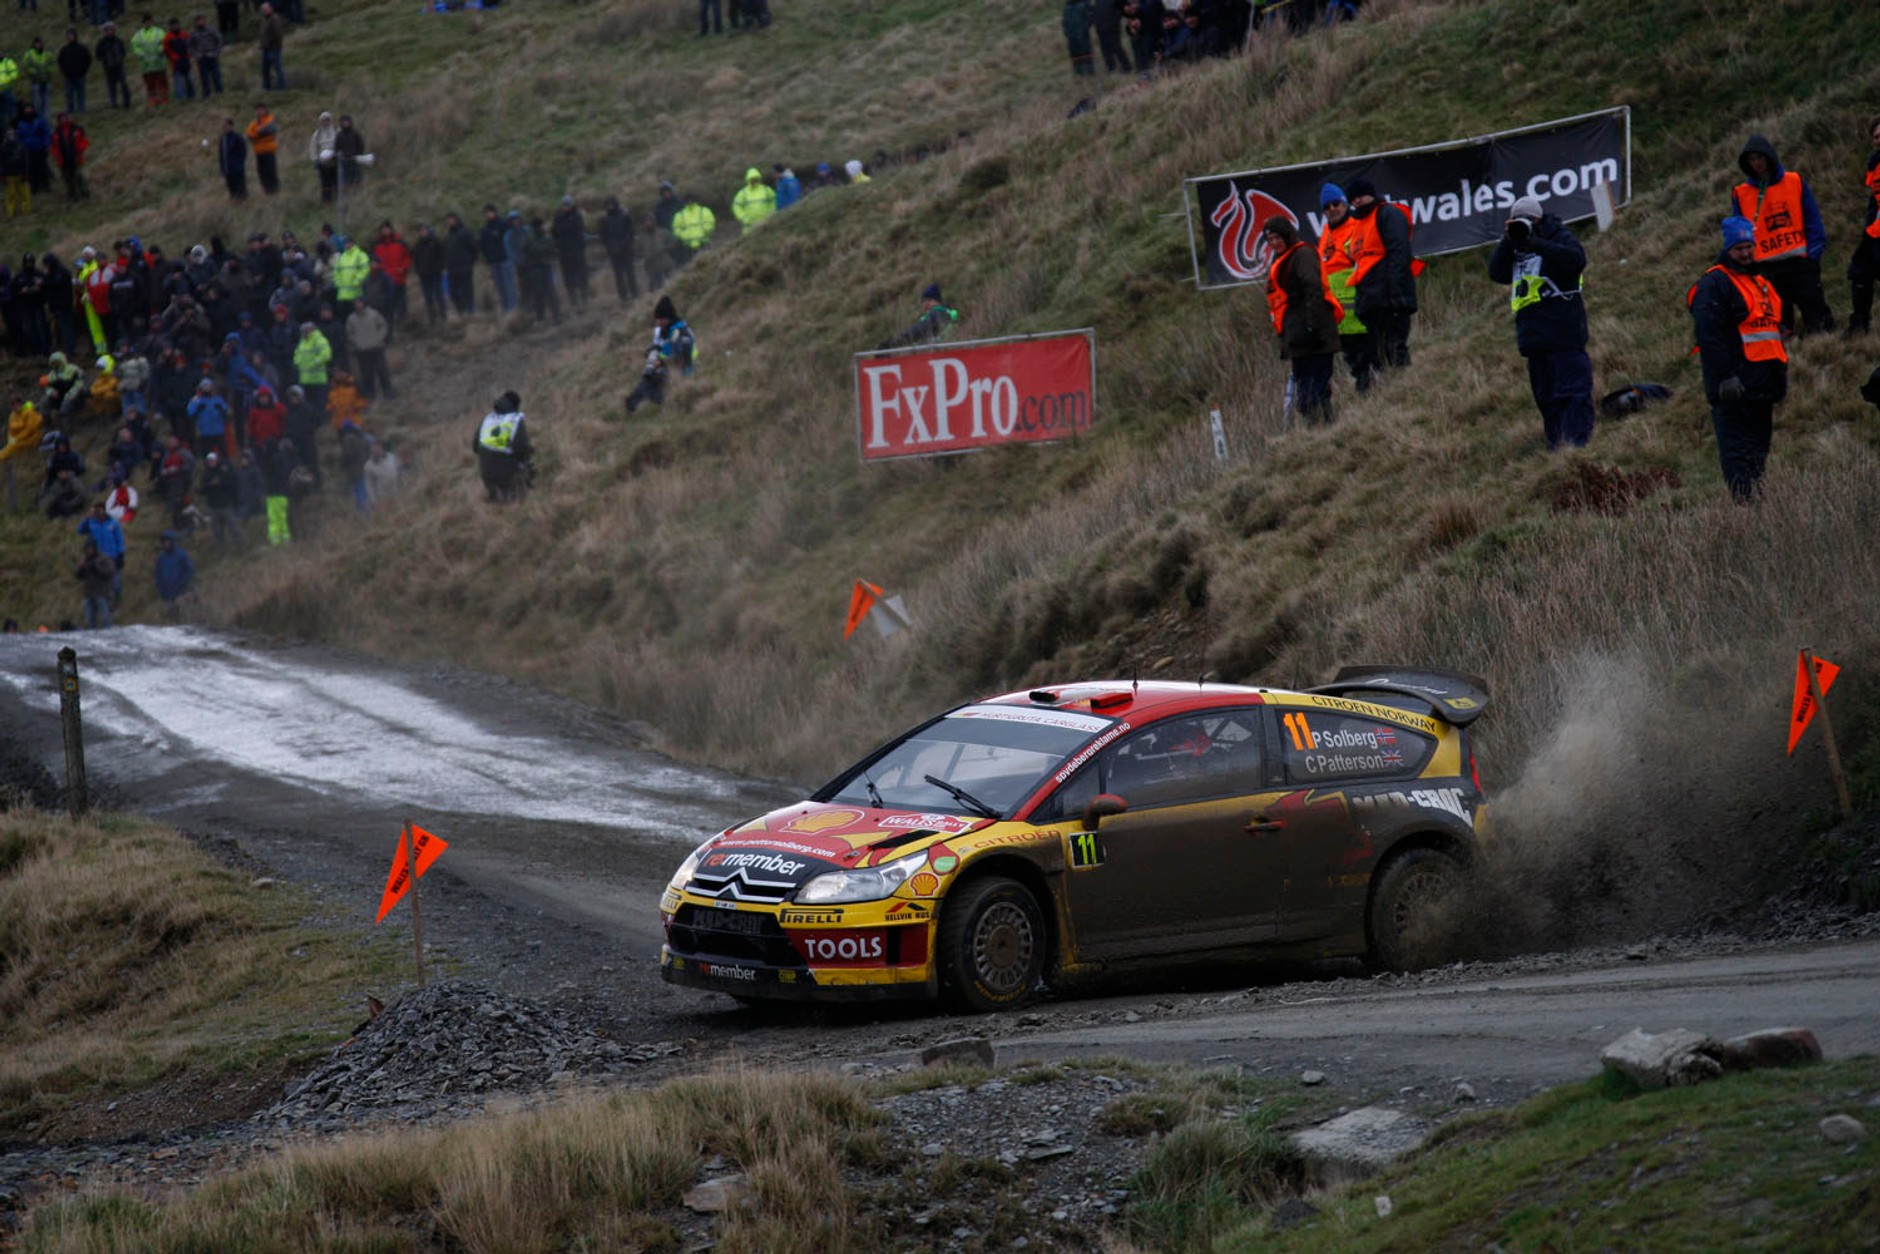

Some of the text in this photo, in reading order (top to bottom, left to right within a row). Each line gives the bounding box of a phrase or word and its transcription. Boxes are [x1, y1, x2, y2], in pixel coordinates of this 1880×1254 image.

[1307, 157, 1618, 238] vwalescom
[863, 357, 1087, 448] FxPro.com
[1283, 711, 1315, 750] 11
[1375, 706, 1436, 731] NORWAY
[1311, 729, 1378, 750] P Solberg
[1305, 754, 1384, 773] C Patterson
[1078, 833, 1098, 864] 11
[780, 908, 843, 923] PIRELLI
[804, 936, 882, 960] TOOLS
